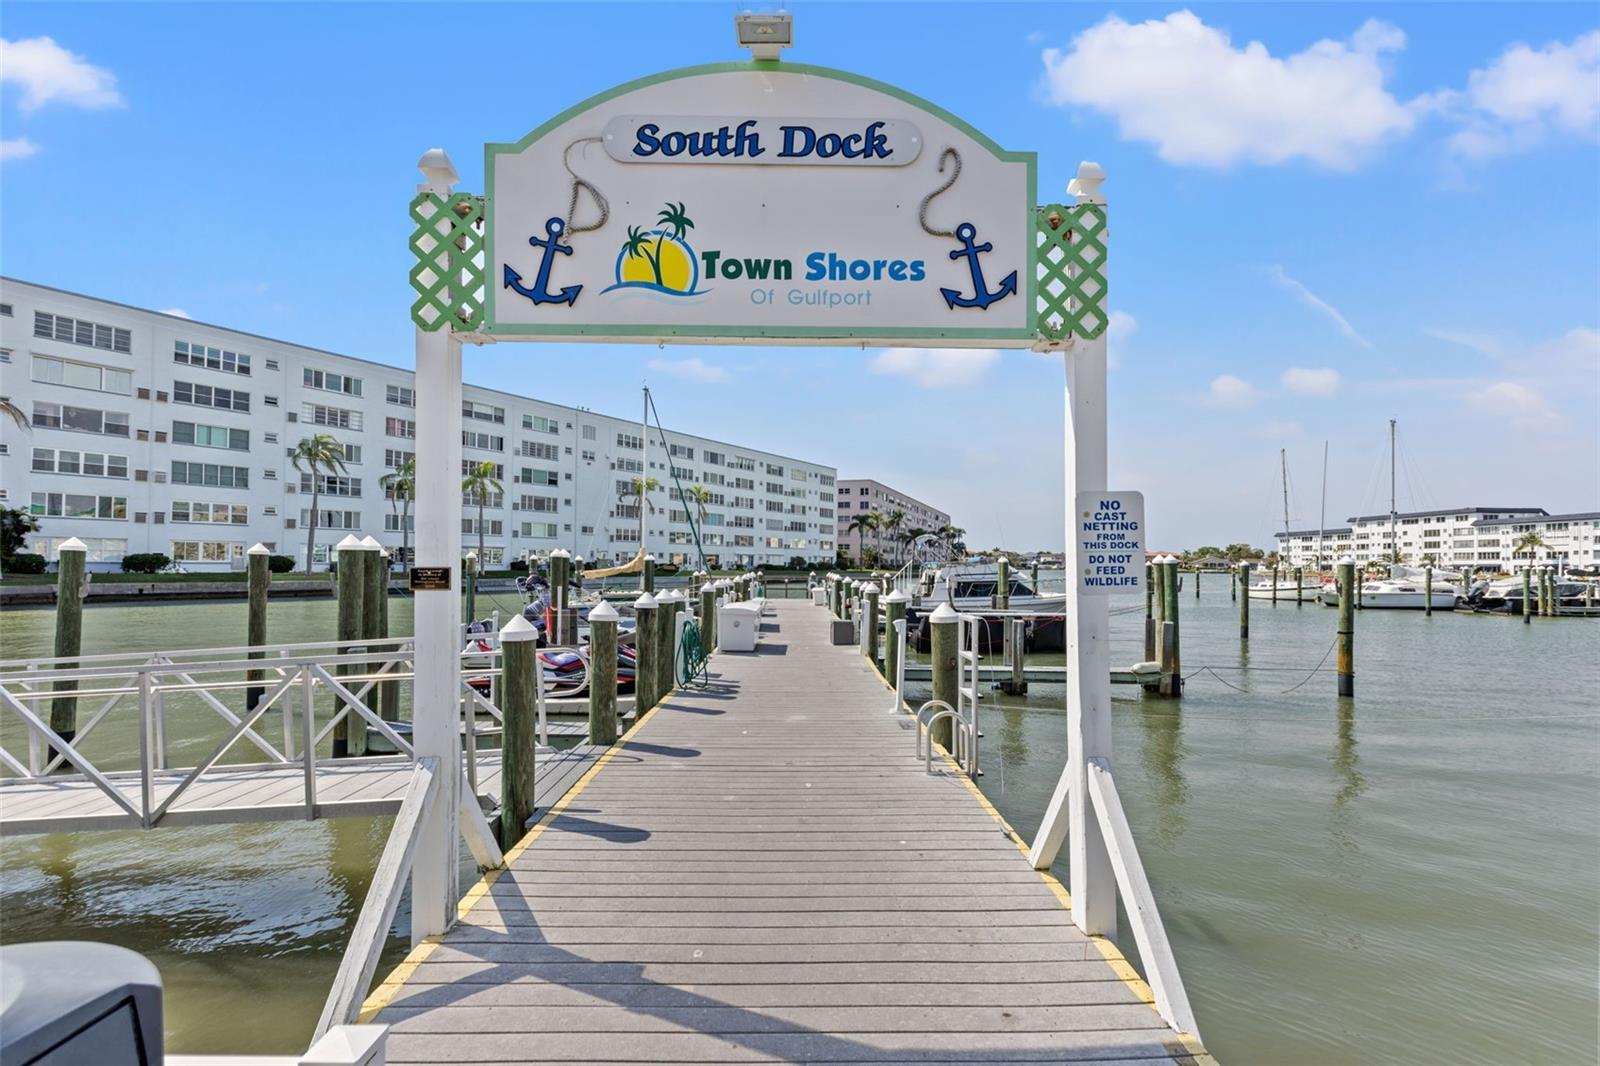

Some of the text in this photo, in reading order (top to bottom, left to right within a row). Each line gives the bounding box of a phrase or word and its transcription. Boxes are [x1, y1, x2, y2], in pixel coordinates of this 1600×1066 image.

[632, 120, 894, 159] South Dock
[701, 250, 926, 282] Town Shores
[750, 289, 872, 308] Of Gulfport
[1100, 500, 1121, 511] NO
[1094, 512, 1127, 521] CAST
[1083, 522, 1138, 531] NETTING
[1096, 533, 1126, 541] FROM
[1110, 541, 1140, 549] DOCK
[1088, 555, 1132, 564] DO NOT
[1096, 566, 1126, 575] FEED
[1084, 577, 1138, 586] WILDLIFE
